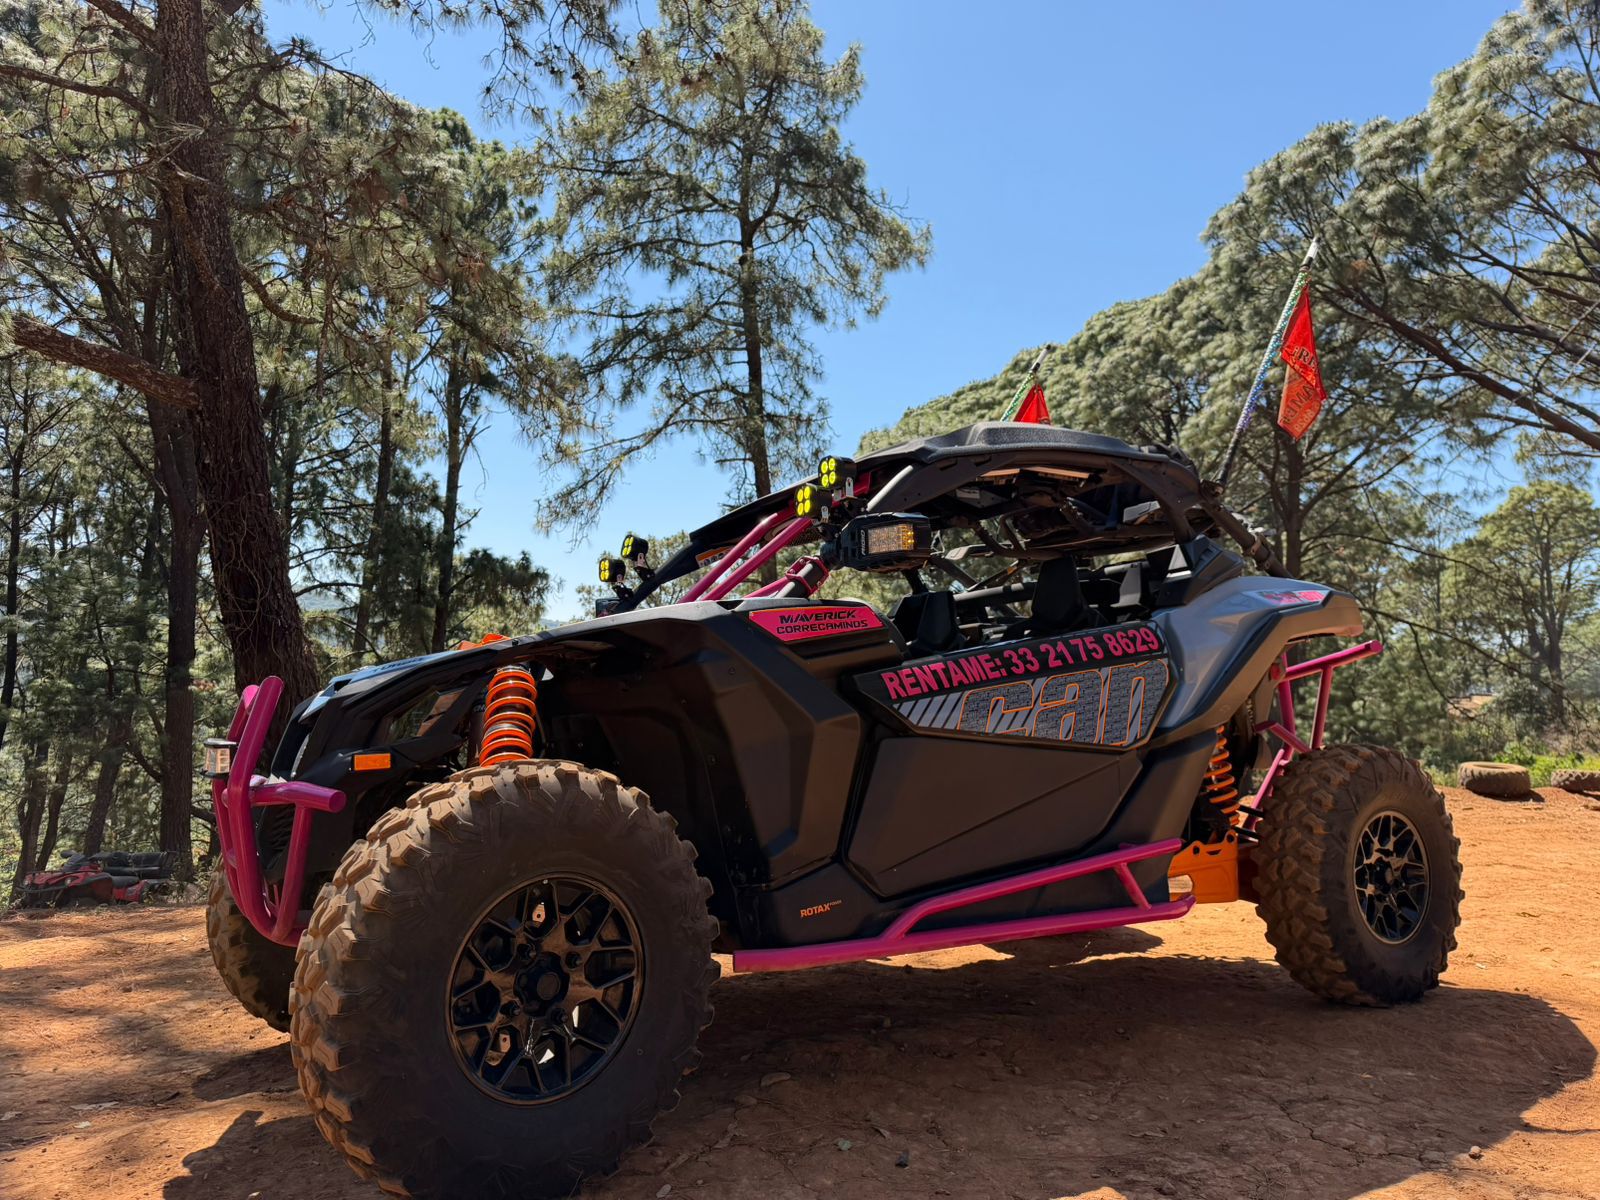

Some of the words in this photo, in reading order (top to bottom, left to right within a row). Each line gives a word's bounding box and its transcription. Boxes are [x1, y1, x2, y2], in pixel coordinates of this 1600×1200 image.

[779, 609, 857, 625] MAVERICK
[776, 619, 868, 635] CORRECAMINOS
[881, 653, 1008, 700] RENTAME:
[1003, 647, 1040, 675] 33
[1103, 626, 1160, 656] 8629
[800, 903, 831, 918] ROTAX
